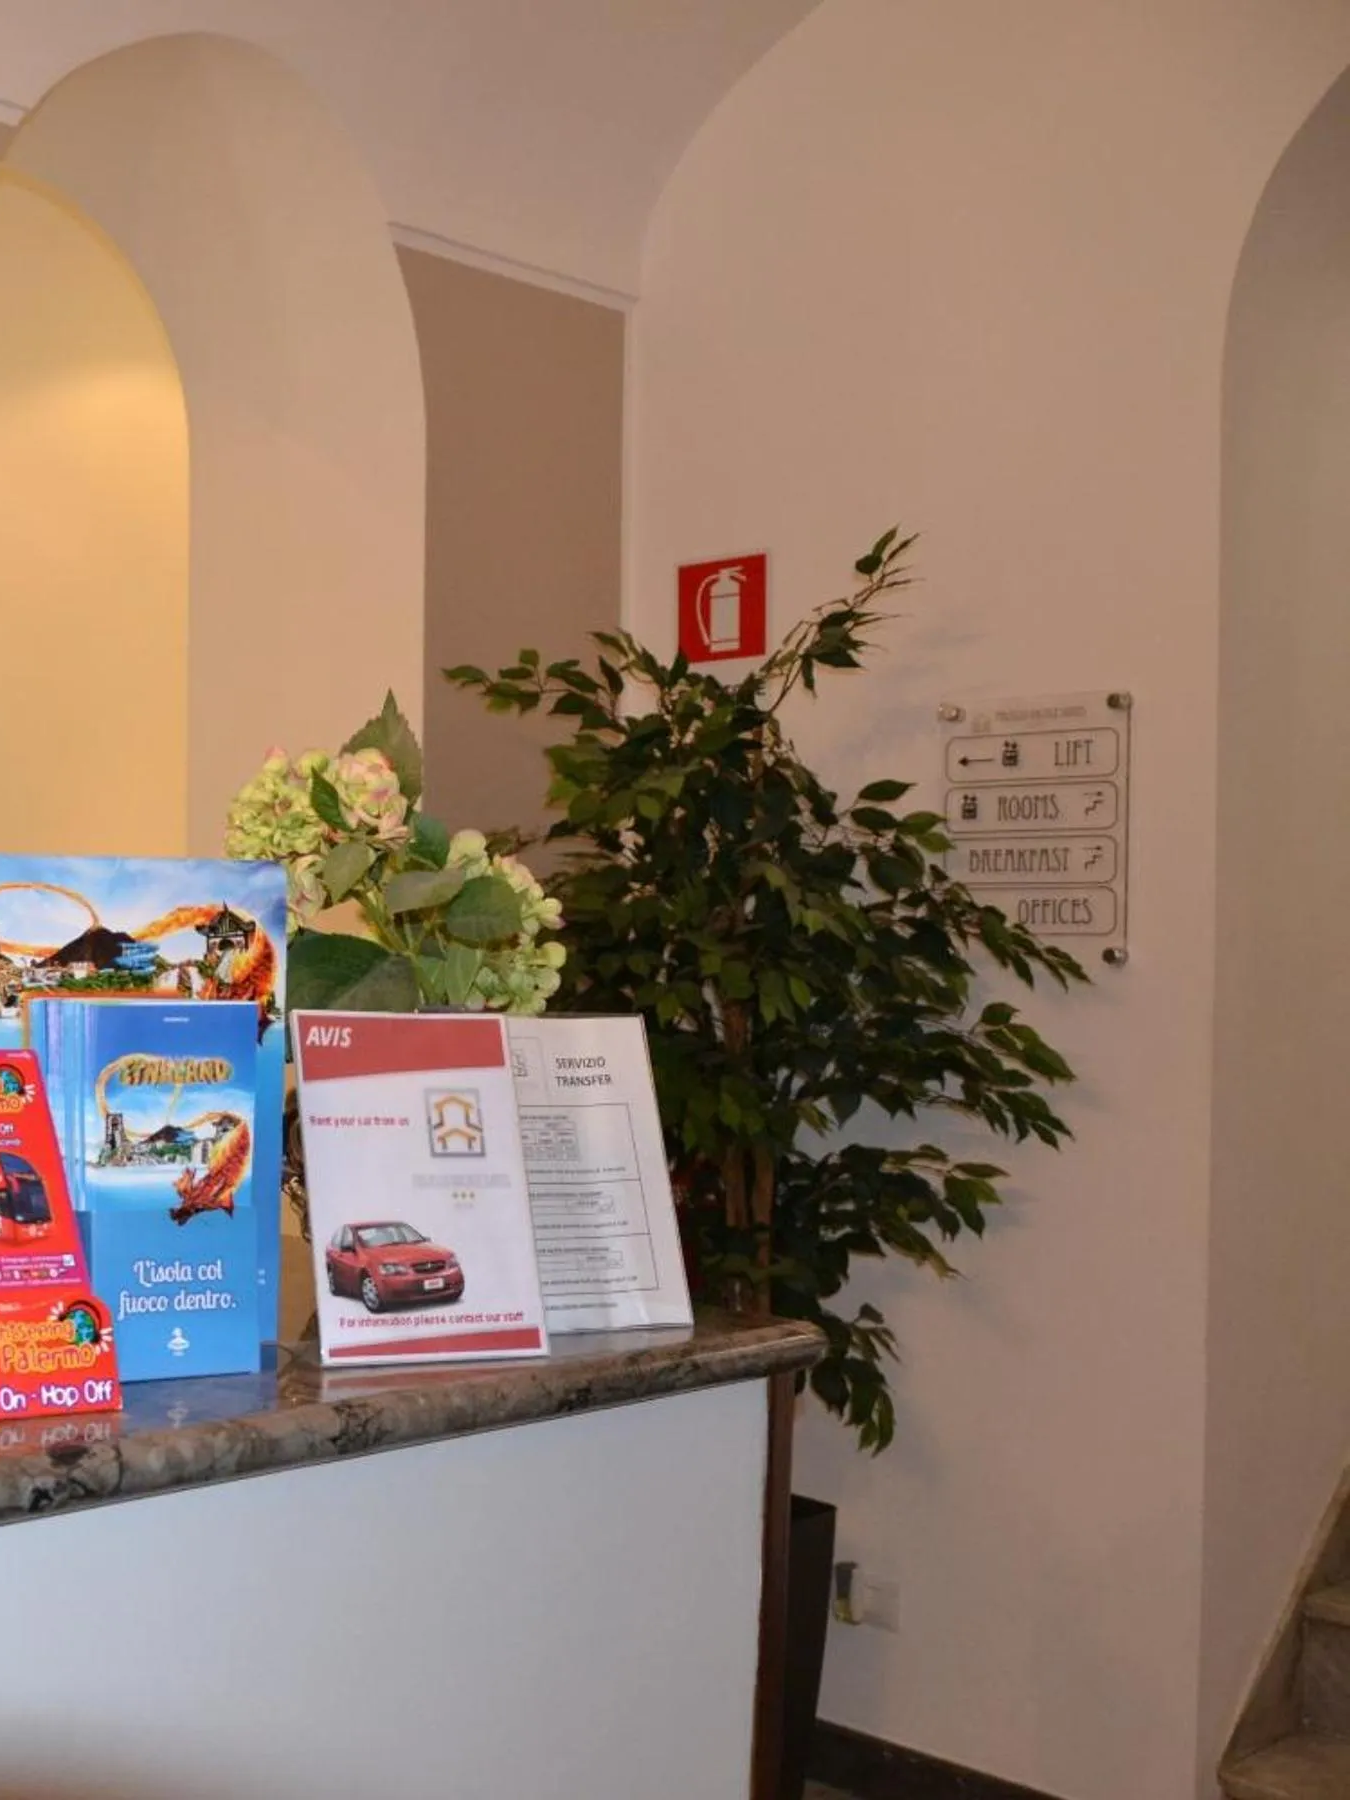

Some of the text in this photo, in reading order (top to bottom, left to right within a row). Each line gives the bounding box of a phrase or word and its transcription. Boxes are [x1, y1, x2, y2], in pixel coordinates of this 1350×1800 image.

[1054, 739, 1093, 767] LIFT
[997, 794, 1061, 821] ROOMS
[969, 848, 1069, 873] BREAKFAST
[1017, 898, 1093, 925] OFFICES
[305, 1026, 353, 1049] AVIS
[554, 1057, 607, 1069] SERVIZIO
[554, 1074, 612, 1087] TRANSFER
[132, 1257, 223, 1287] L'isola col
[117, 1288, 237, 1321] fuoco dentro.
[358, 1315, 412, 1327] information
[0, 1344, 96, 1374] Palermo
[0, 1386, 27, 1412] On
[40, 1384, 80, 1408] Hop
[83, 1379, 114, 1403] Off
